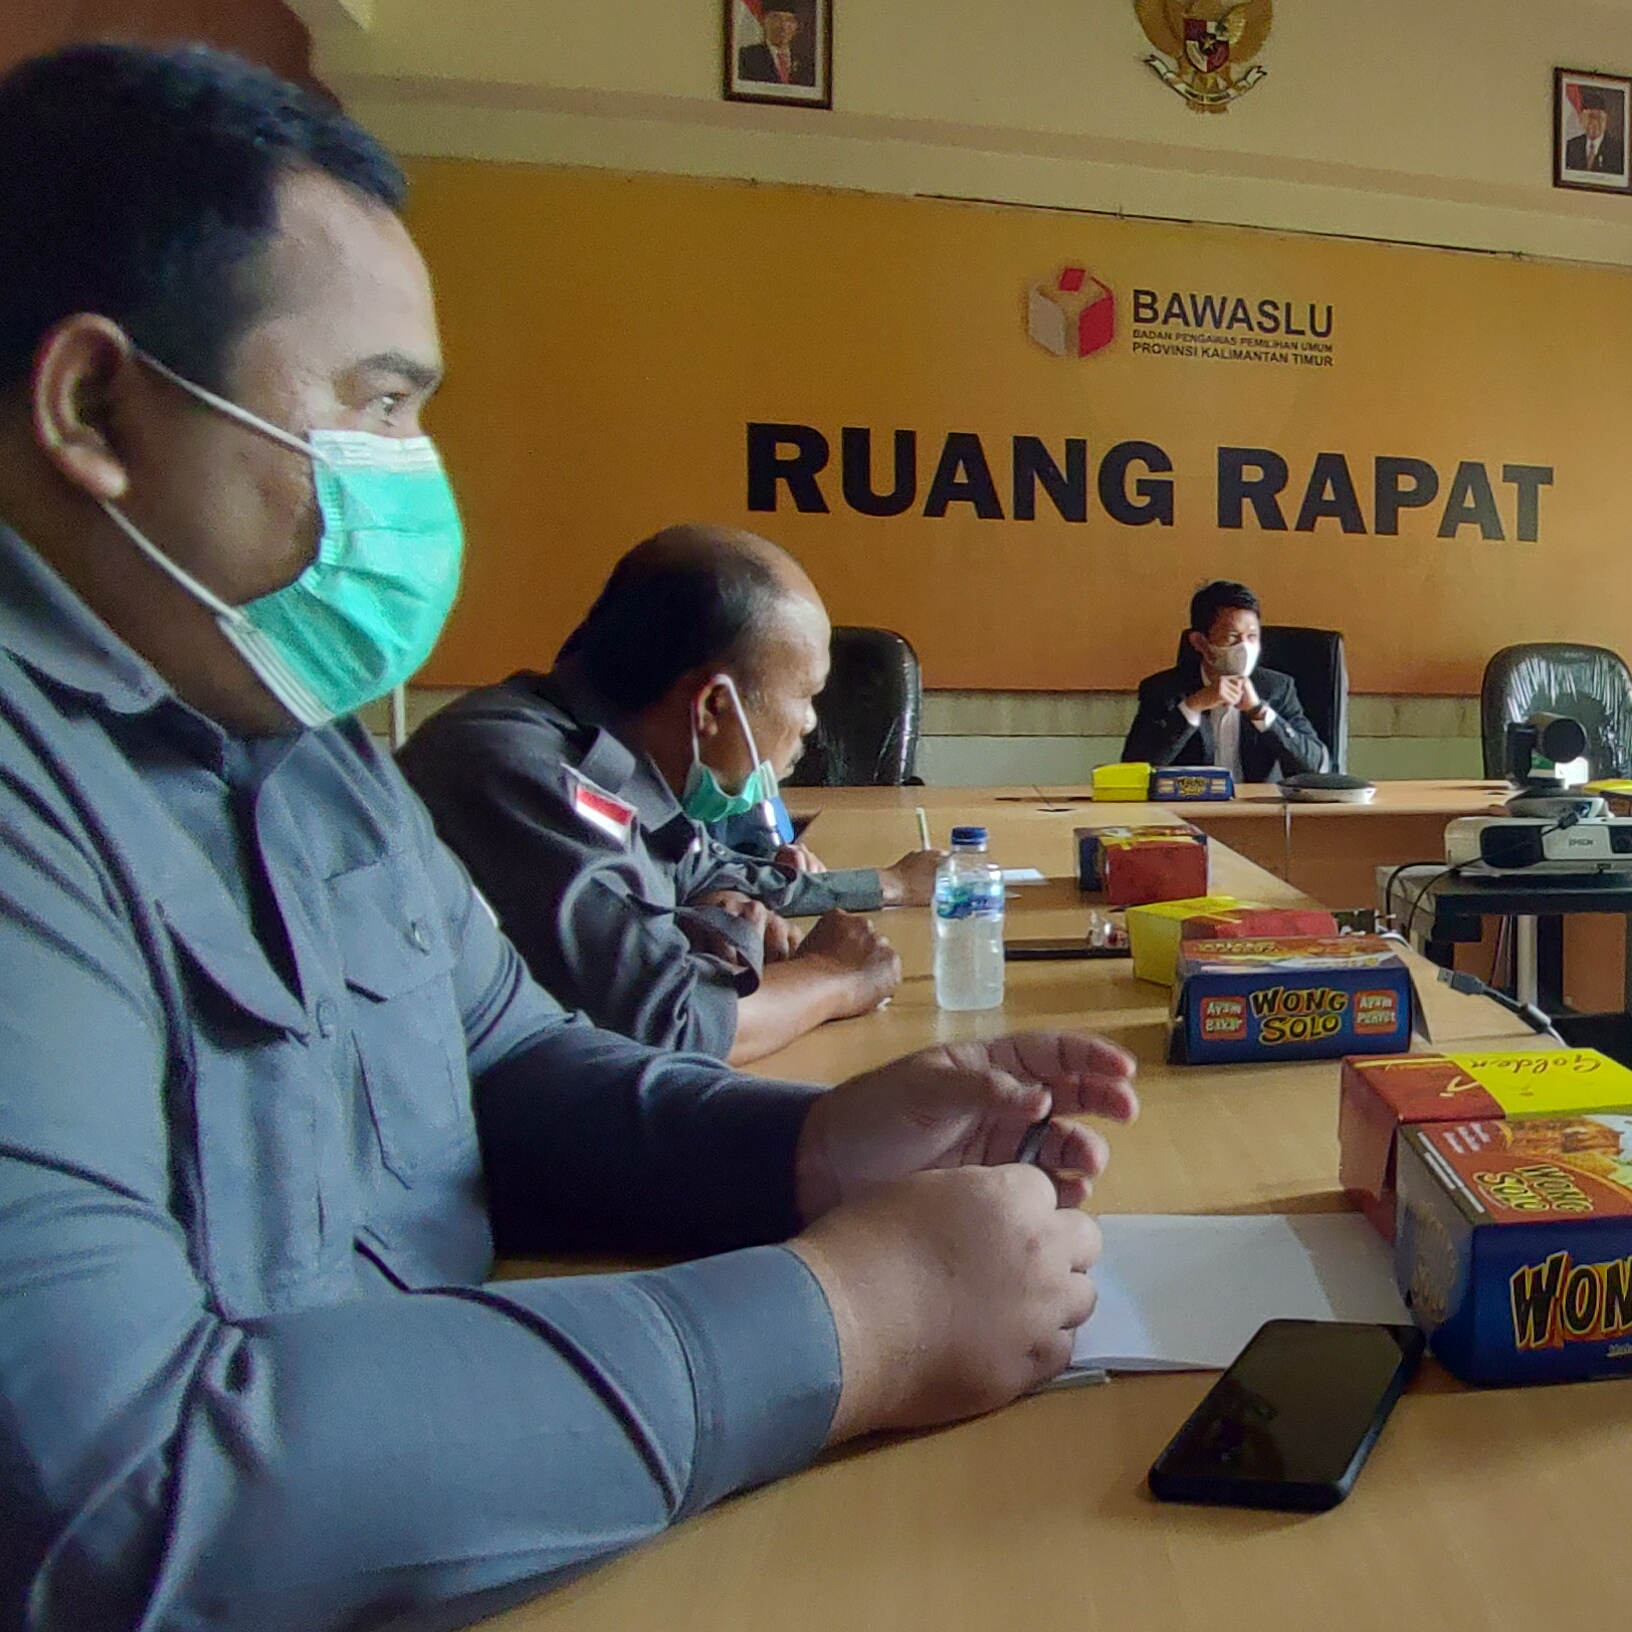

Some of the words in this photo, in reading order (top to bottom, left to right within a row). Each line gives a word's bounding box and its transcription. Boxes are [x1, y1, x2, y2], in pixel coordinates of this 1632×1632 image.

[1132, 289, 1334, 338] BAWASLU
[1132, 329, 1173, 341] BADAN
[1175, 332, 1237, 346] PENGAWAS
[1240, 337, 1298, 349] PEMILIHAN
[1301, 342, 1333, 352] UMUM
[1132, 341, 1197, 356] PROVINSI
[1201, 347, 1288, 363] KALIMANTAN
[1291, 353, 1334, 366] TIMUR
[746, 422, 1174, 526] RUANG
[1216, 446, 1554, 541] RAPAT
[1250, 987, 1348, 1016] WONG
[1259, 1014, 1342, 1044] SOLO
[1473, 1171, 1550, 1212] SOLO
[1514, 1163, 1594, 1213] WONG
